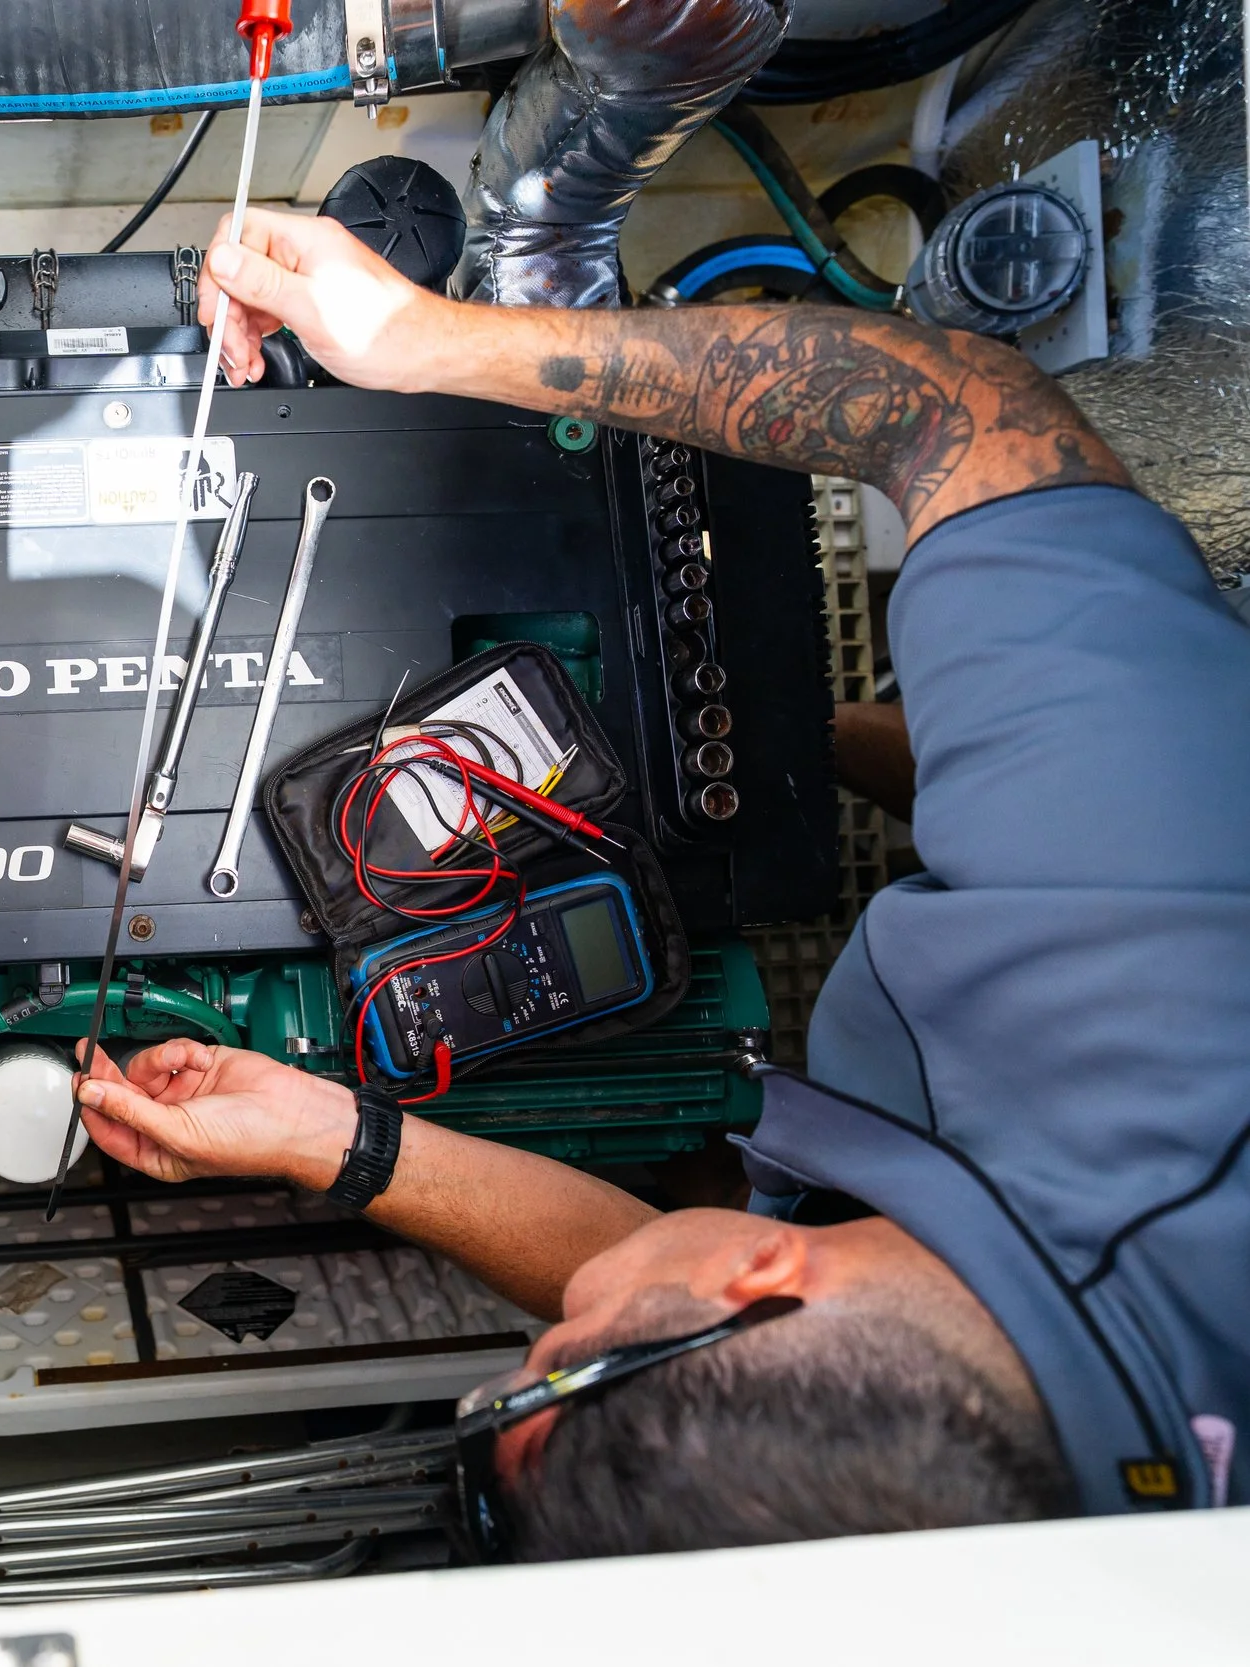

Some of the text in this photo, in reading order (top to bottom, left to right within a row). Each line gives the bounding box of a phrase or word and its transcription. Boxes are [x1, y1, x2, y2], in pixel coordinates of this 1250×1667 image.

[45, 650, 324, 696] PENTA
[530, 922, 538, 936] RANGE
[407, 1030, 420, 1057] K8315
